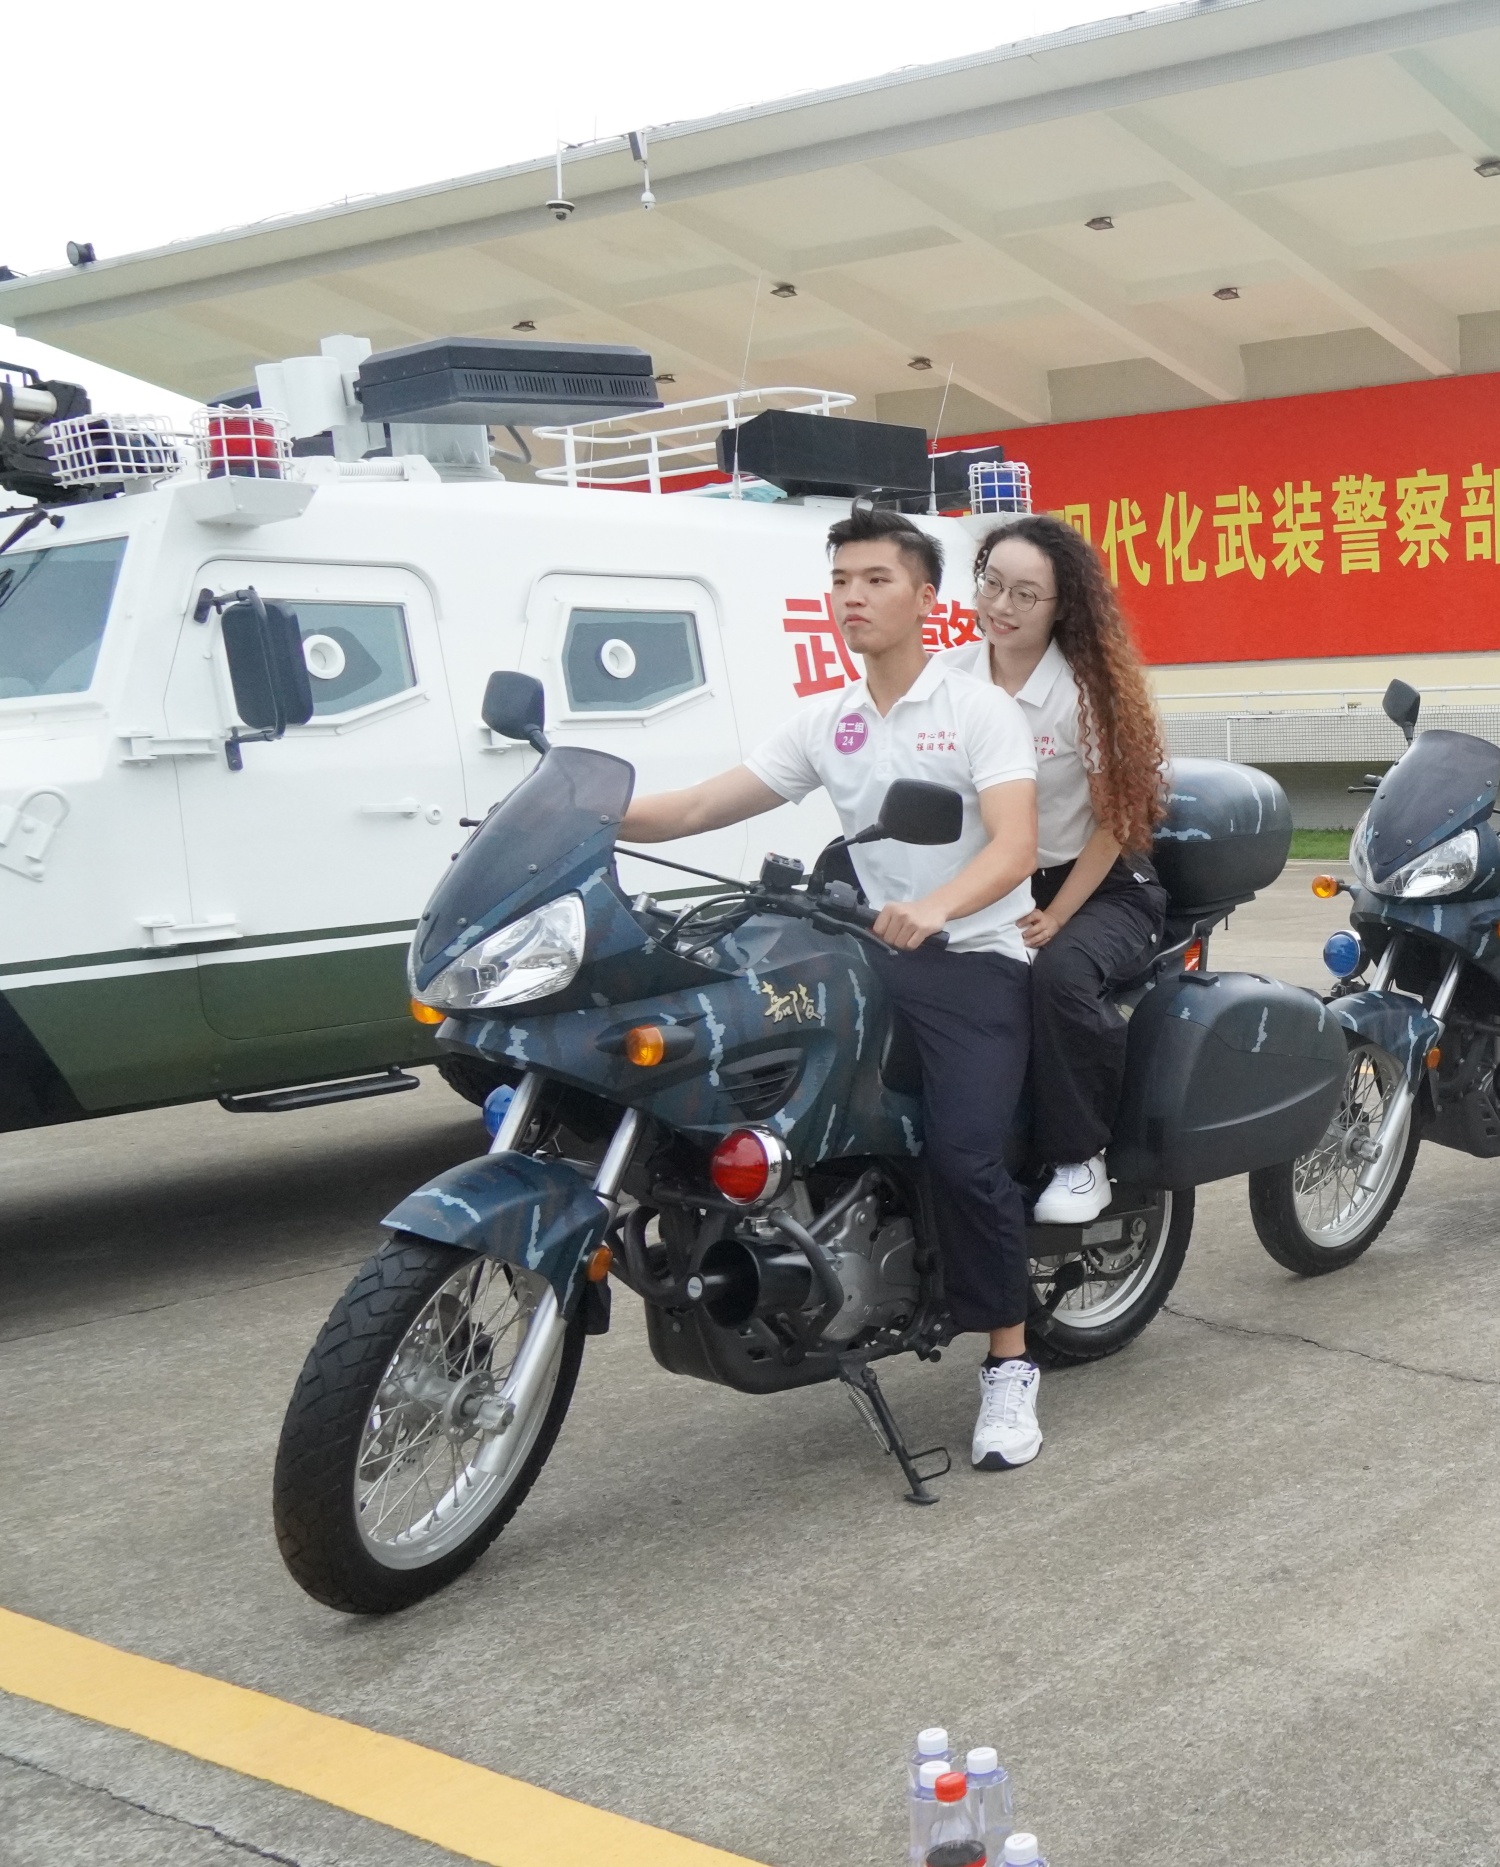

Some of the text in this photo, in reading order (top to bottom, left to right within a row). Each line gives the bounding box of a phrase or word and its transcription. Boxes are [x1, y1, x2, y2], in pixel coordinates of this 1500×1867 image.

[837, 722, 866, 734] 第二组
[842, 735, 855, 747] 24
[917, 730, 957, 741] 同心同行
[916, 742, 957, 752] 强国有我
